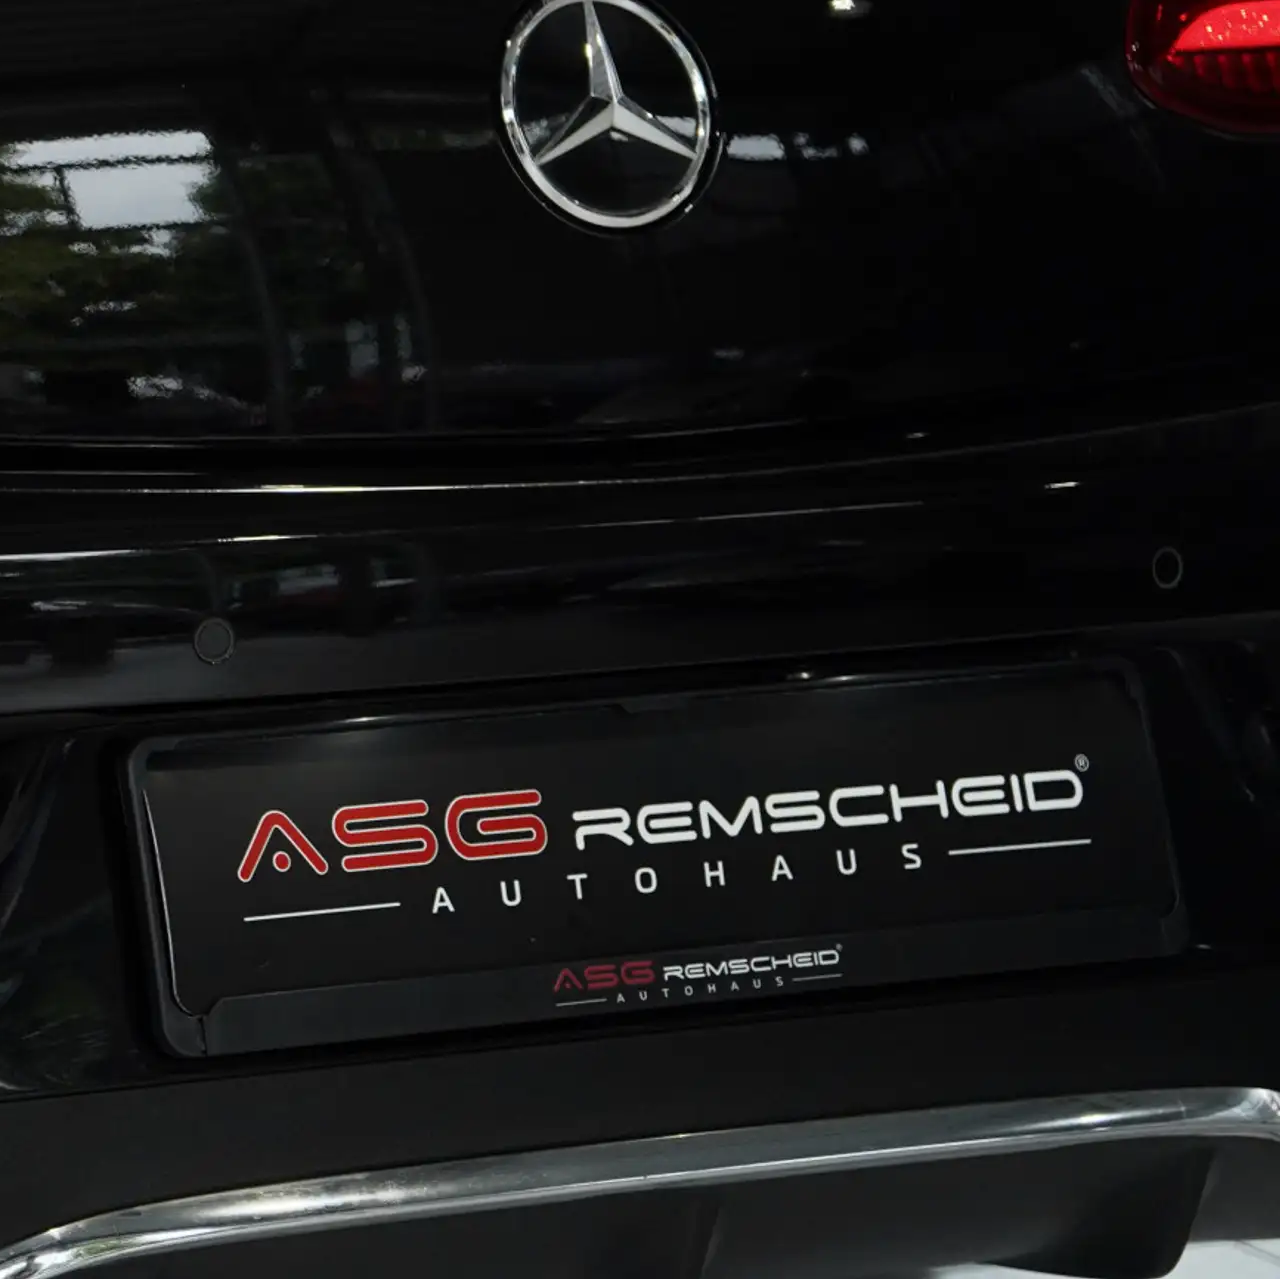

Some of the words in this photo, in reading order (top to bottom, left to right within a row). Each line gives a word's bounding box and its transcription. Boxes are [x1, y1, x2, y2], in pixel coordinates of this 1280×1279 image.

[236, 788, 549, 884] ASG
[431, 843, 923, 914] AUTOHAUS
[553, 960, 655, 993] ASG
[616, 975, 784, 1004] AUTOHAUS
